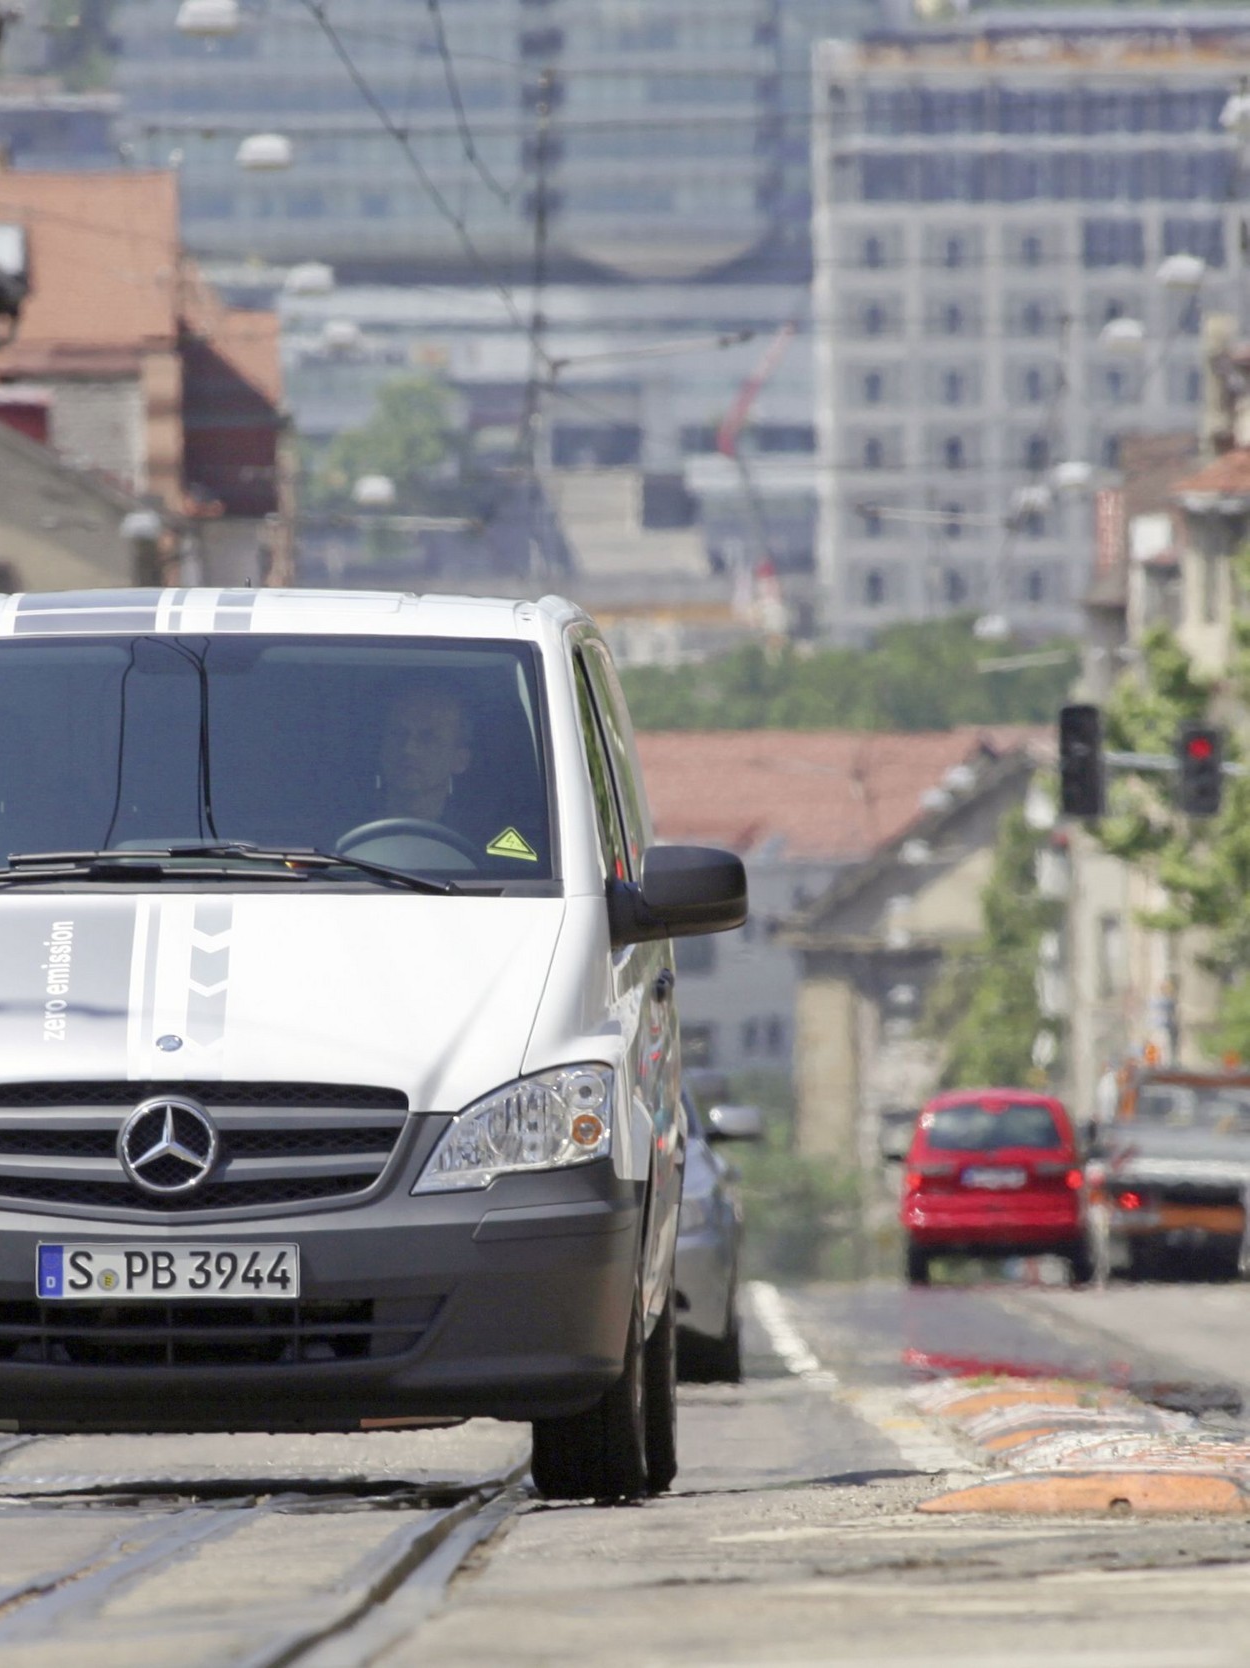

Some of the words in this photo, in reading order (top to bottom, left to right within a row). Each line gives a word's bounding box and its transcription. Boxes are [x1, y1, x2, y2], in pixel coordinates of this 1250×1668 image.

[41, 920, 74, 995] emission
[43, 999, 66, 1042] zero
[46, 1276, 56, 1288] D
[68, 1251, 93, 1290] S
[124, 1251, 177, 1290] PB
[188, 1251, 291, 1290] 3944
